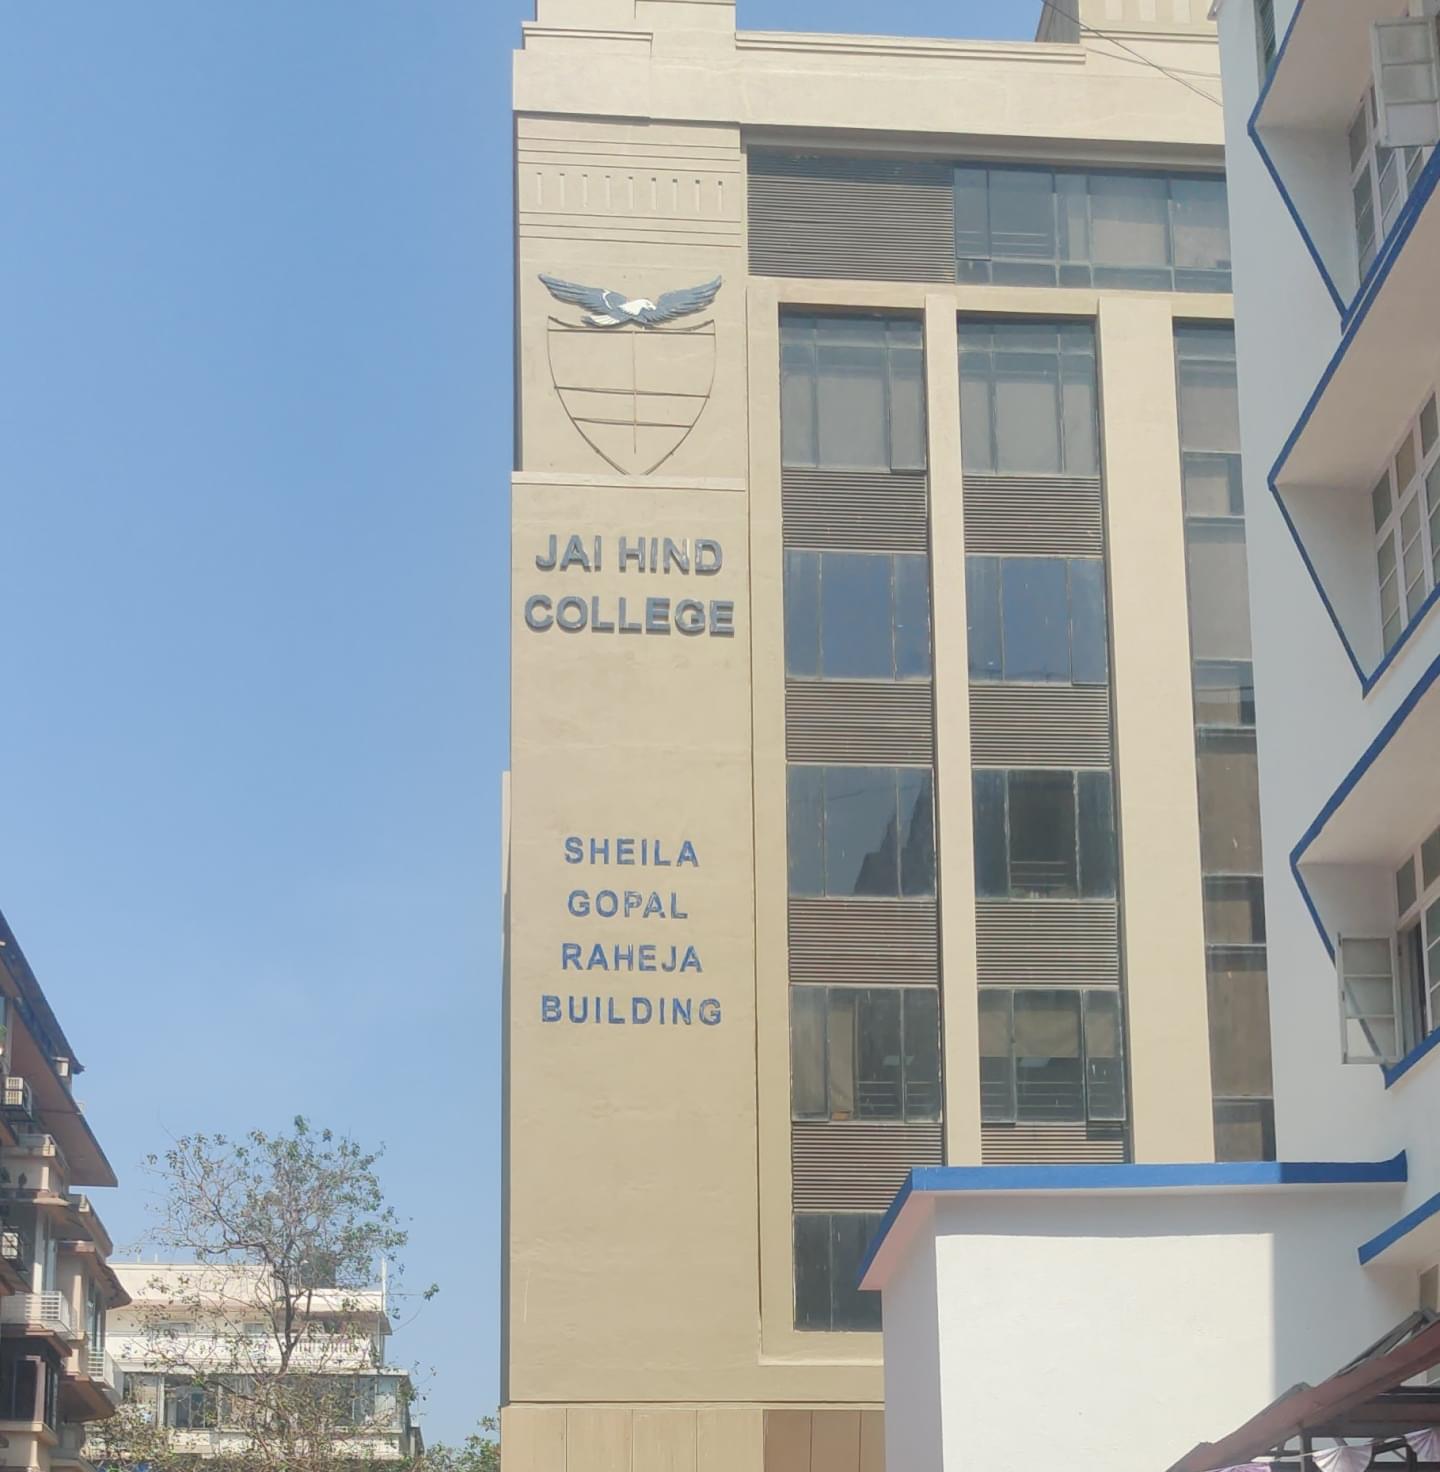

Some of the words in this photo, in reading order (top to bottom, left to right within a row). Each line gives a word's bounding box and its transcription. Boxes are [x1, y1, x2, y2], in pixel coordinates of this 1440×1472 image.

[535, 534, 602, 572] JAI
[618, 536, 723, 576] HIND
[524, 594, 735, 638] COLLEGE
[564, 836, 699, 867] SHEILA
[567, 889, 688, 919] GOPAL
[561, 943, 703, 973] RAHEJA
[541, 994, 721, 1026] BUILDING
